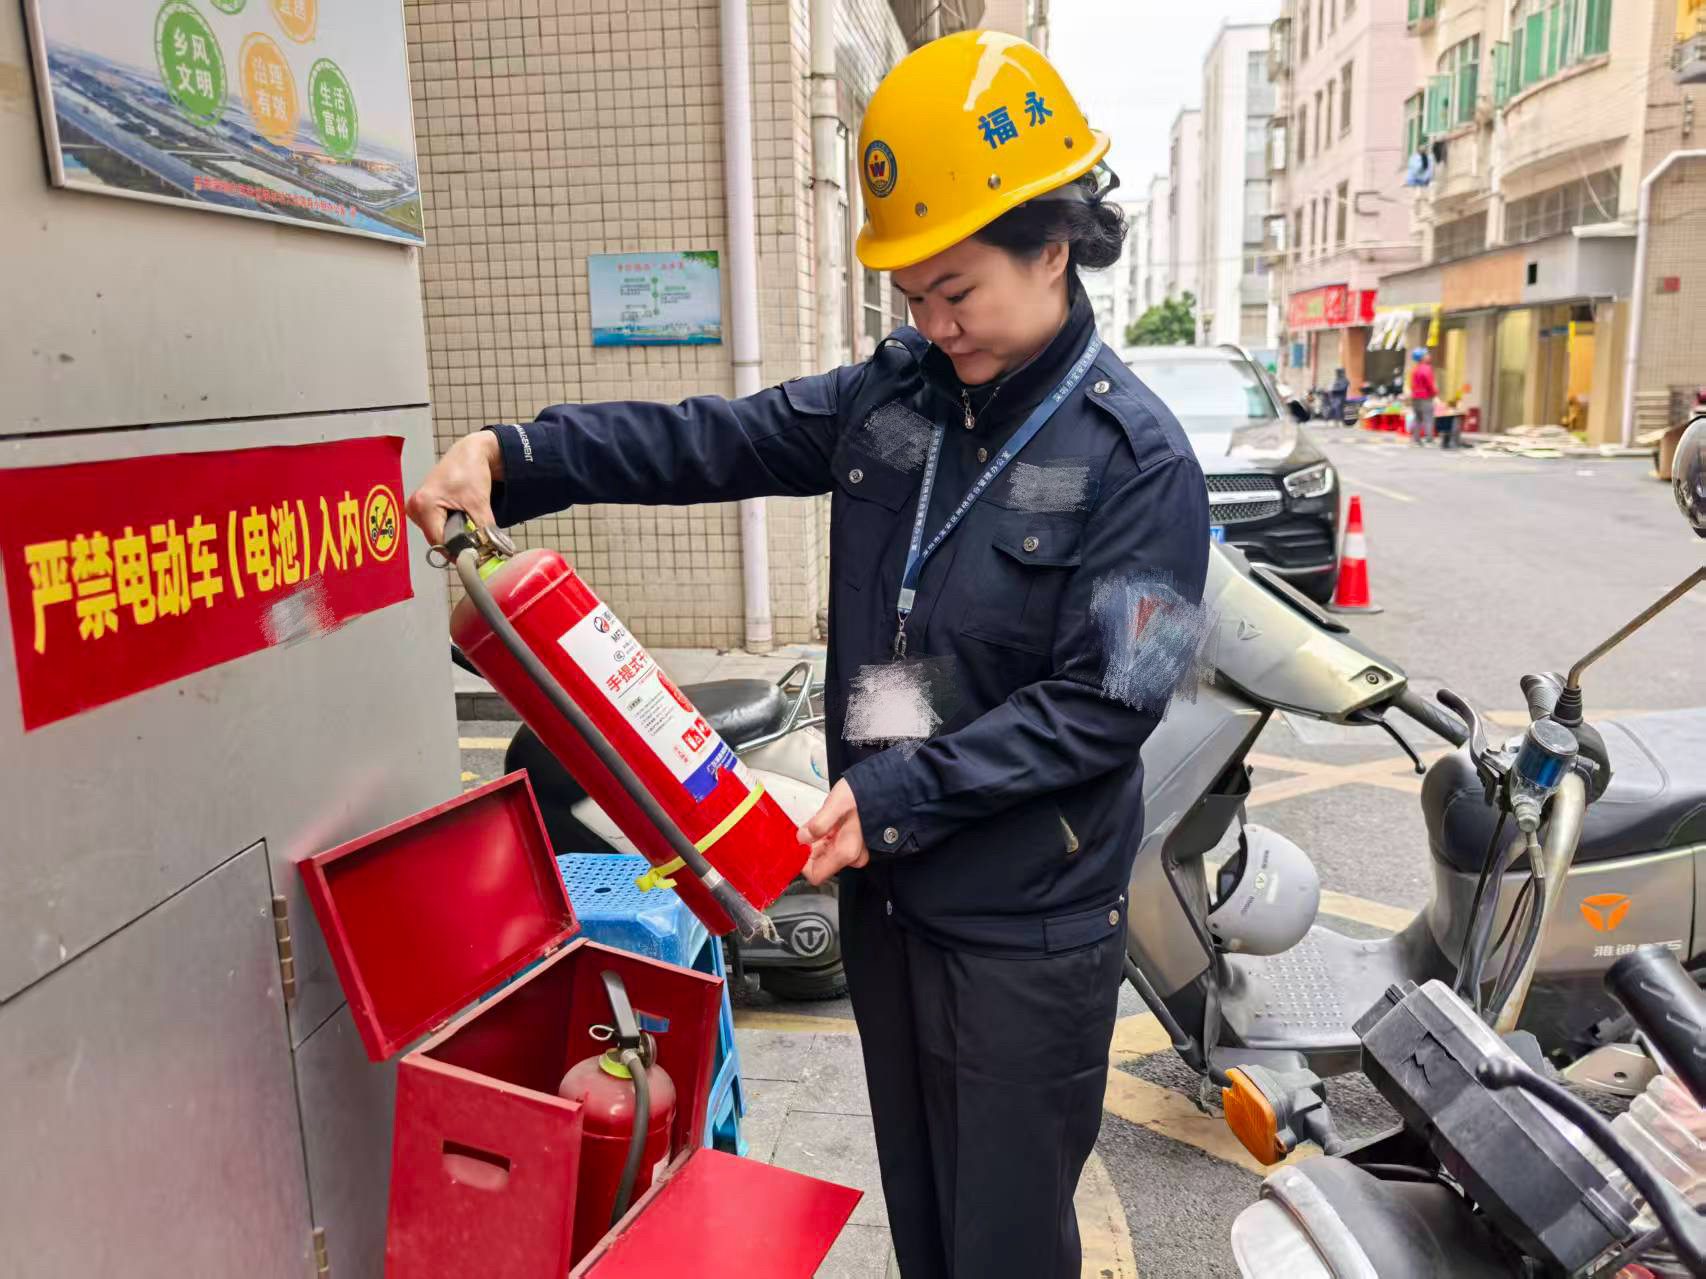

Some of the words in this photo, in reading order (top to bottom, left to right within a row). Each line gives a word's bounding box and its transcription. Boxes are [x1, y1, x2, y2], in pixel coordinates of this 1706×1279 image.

[174, 27, 211, 65] 乡风
[176, 62, 214, 98] 文明
[978, 91, 1053, 149] 福永
[24, 491, 363, 654] 严禁电动车（电池）入内
